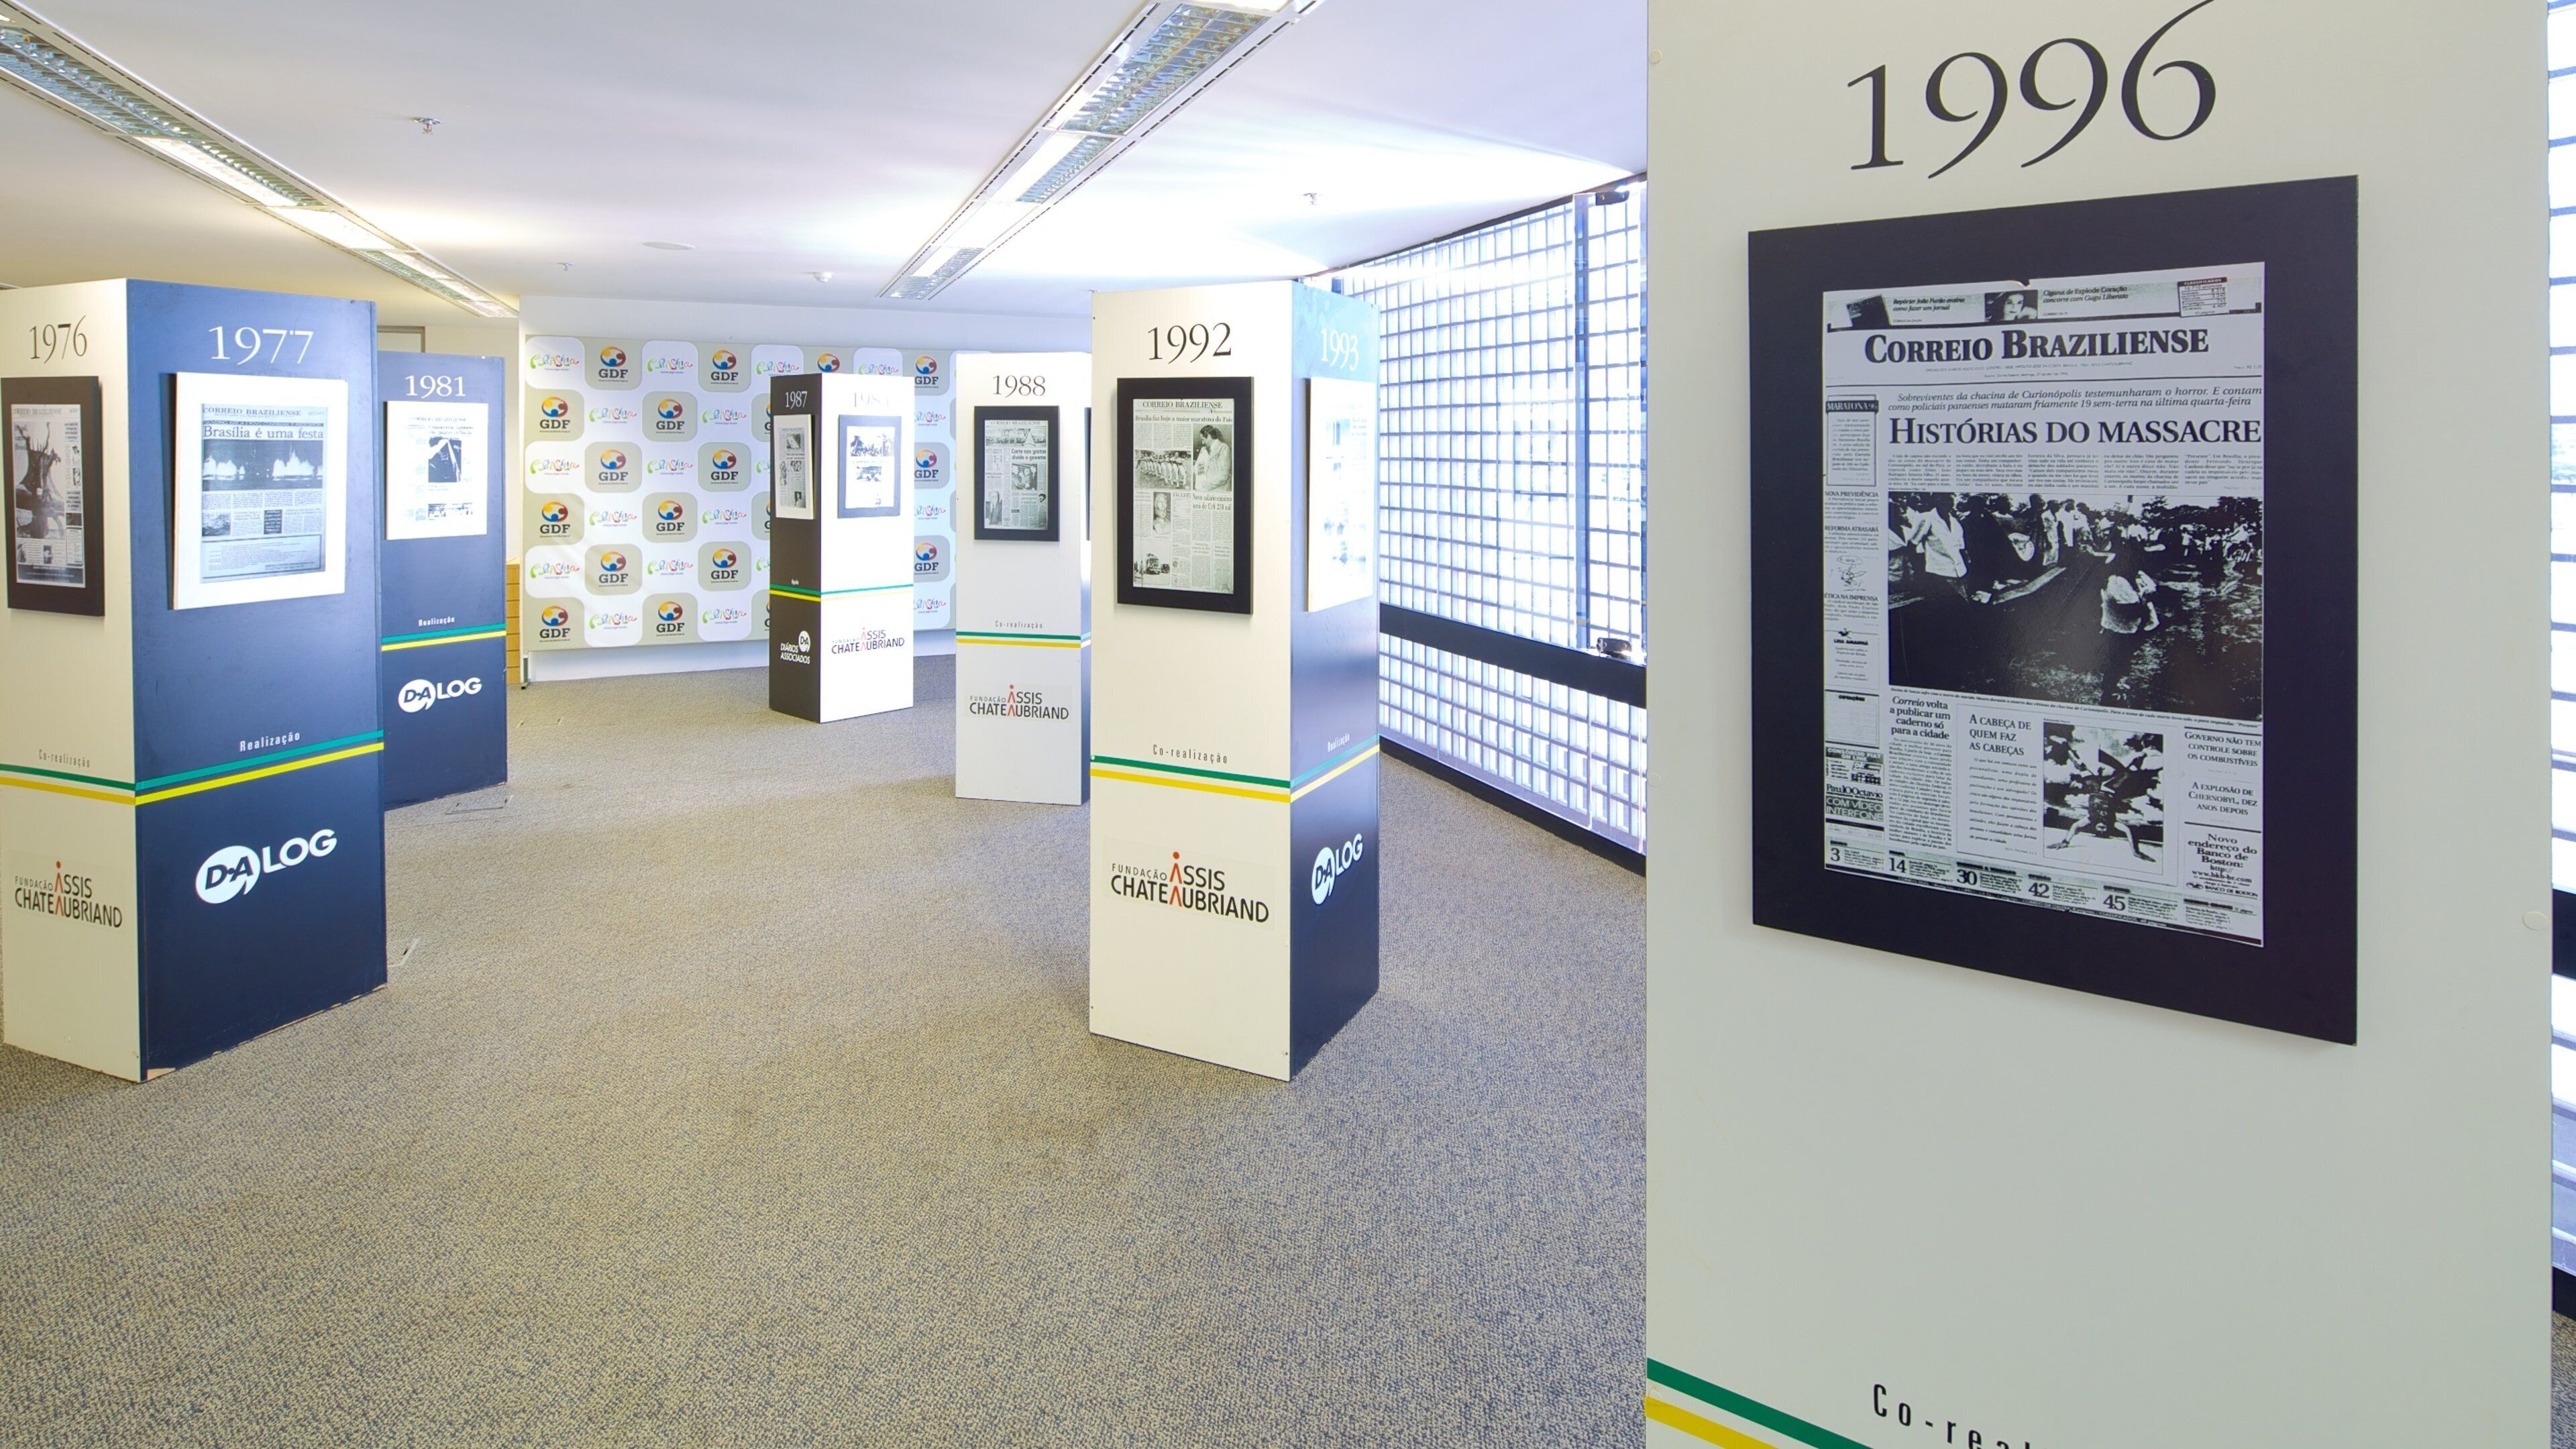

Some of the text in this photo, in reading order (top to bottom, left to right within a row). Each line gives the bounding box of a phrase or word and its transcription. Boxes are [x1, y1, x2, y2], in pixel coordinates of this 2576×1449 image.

[1847, 0, 2216, 178] 1996
[30, 315, 87, 364] 1976
[209, 325, 314, 365] 1977
[1148, 322, 1232, 364] 1992
[1865, 329, 2209, 363] CORREIO BRAZILIENSE
[1320, 327, 1360, 371] 1993
[598, 368, 628, 379] GDF
[711, 372, 739, 381] GDF
[914, 376, 938, 385] GDF
[405, 375, 466, 399] 1981
[992, 374, 1046, 397] 1988
[785, 390, 808, 410] 1987
[1898, 393, 1954, 402] Sobreviventes
[1956, 393, 1968, 401] da
[1970, 392, 2006, 400] chacina
[2008, 391, 2020, 399] de
[2022, 389, 2082, 400] Curionópolis
[2085, 388, 2162, 398] testemunharam
[2176, 387, 2209, 395] horror.
[2213, 386, 2220, 395] E
[2222, 386, 2262, 394] contam
[1175, 400, 1223, 409] BRAZILIENSE
[1912, 402, 1946, 413] policiais
[1947, 402, 1988, 412] paraenses
[1991, 401, 2030, 410] mataram
[2032, 400, 2077, 410] friamente
[2080, 400, 2091, 409] 19
[2093, 399, 2139, 408] sem-terra
[2141, 399, 2153, 407] na
[2155, 398, 2189, 407] última
[2190, 397, 2251, 408] quarta-feira
[540, 419, 570, 429] GDF
[656, 421, 685, 430] GDF
[1889, 417, 2261, 444] HISTÓRIAS DO MASSACRE
[204, 426, 323, 439] Brasília é uma festa
[711, 471, 739, 480] GDF
[656, 522, 685, 532] GDF
[914, 562, 938, 571] GDF
[711, 570, 739, 580] GDF
[418, 616, 455, 627] Realização
[656, 623, 685, 633] GDF
[995, 621, 1043, 629] Co-realização
[861, 629, 886, 641] ASSIS
[780, 642, 798, 653] DIÁRIOS
[831, 637, 905, 655] CHATEAUBRIAND
[780, 653, 810, 664] ASSOCIADOS
[437, 677, 482, 700] LOG
[1007, 690, 1042, 705] ASSIS
[1892, 696, 1948, 710] Correio volta
[969, 702, 1069, 720] CHATEAUBRIAND
[1896, 707, 1933, 718] publicar
[1896, 717, 1944, 729] caderno só
[1969, 714, 2032, 730] A CABEÇA DE
[1891, 727, 1911, 735] para
[1920, 729, 1949, 740] cidade
[1970, 729, 2017, 742] QUEM FAZ
[2184, 731, 2224, 743] GOVERNO
[2226, 737, 2243, 745] NÃO
[239, 731, 301, 752] Realização
[1328, 733, 1350, 753] Realização
[1152, 744, 1227, 764] Co-realização
[1969, 742, 2025, 757] AS CABEÇAS
[2188, 743, 2258, 757] CONTROLE SOBRE
[39, 749, 90, 768] Co-realização
[2200, 754, 2258, 767] COMBUSTÍVEIS
[2192, 782, 2199, 790] A
[2200, 784, 2241, 794] EXPLOSÃO
[1826, 796, 1883, 812] COM VÍDEO
[2188, 791, 2258, 807] CHERNOBYL, DEZ
[1825, 806, 1884, 822] INTERFONE
[2197, 804, 2249, 816] ANOS DEPOIS
[2207, 833, 2237, 844] Novo
[262, 829, 337, 873] LOG
[1335, 833, 1363, 876] LOG
[1830, 847, 1840, 861] 3
[2188, 841, 2257, 854] endereço do
[2196, 847, 2249, 861] Banco de
[1889, 857, 1907, 873] 14
[2202, 855, 2243, 868] Boston:
[1112, 861, 1226, 892] FUNDAÇÃO ASSIS
[1956, 869, 1978, 885] 30
[15, 871, 93, 899] FUNDAÇÃO ASSIS
[2028, 882, 2050, 898] 42
[1111, 874, 1269, 923] CHATEAUBRIAND
[2103, 894, 2126, 911] 45
[15, 888, 122, 928] CHATEAUBRIAND
